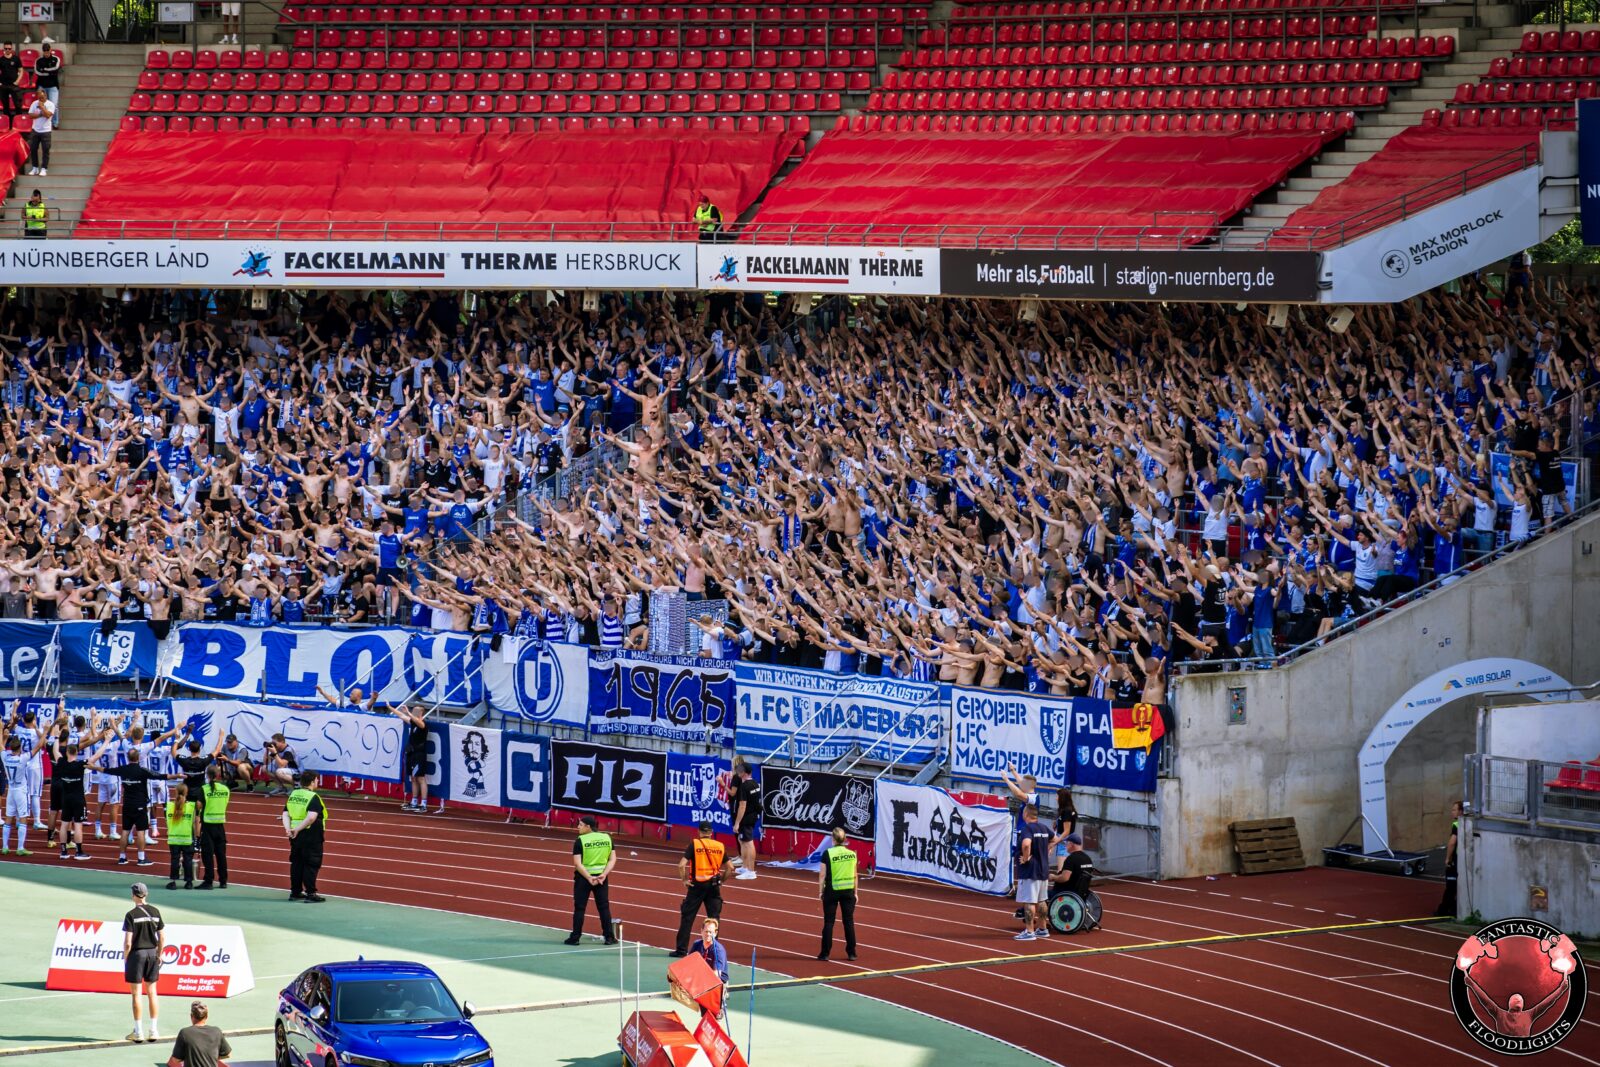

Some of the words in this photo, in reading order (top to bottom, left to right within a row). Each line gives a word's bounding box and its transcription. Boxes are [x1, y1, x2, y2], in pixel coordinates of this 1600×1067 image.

[23, 6, 51, 18] FCN
[1408, 236, 1439, 256] MAX
[1440, 209, 1504, 243] MORLOCK
[13, 248, 149, 268] NÜRNBERGER
[156, 252, 209, 268] LAND
[284, 252, 446, 270] FACKELMANN
[461, 252, 557, 271] THERME
[566, 253, 681, 271] HERSBRUCK
[1413, 236, 1469, 265] STADION
[746, 255, 850, 276] FACKELMANN
[859, 257, 923, 277] THERME
[976, 263, 1012, 283] Mehr
[1016, 264, 1036, 283] als
[1040, 264, 1095, 284] Fußball
[1116, 265, 1275, 291] stadion-nuernberg.de
[173, 627, 491, 704] BLOCK
[616, 648, 626, 658] IST
[676, 655, 697, 666] NICHT
[699, 657, 735, 669] VERLOREN
[754, 668, 773, 683] WIR
[775, 669, 818, 689] KÄMPFEN
[819, 678, 834, 691] MIT
[885, 683, 933, 701] FÄUSTEN
[1465, 674, 1485, 686] SWB
[1486, 669, 1511, 682] SOLAR
[739, 692, 790, 725] 1.FC
[956, 721, 988, 746] 1.FC
[1075, 712, 1111, 735] PLA
[956, 746, 1065, 780] MAGDEBURG
[1093, 746, 1130, 771] OST
[5, 765, 17, 780] 17
[507, 740, 543, 803] G
[763, 774, 843, 825] Sued
[691, 810, 732, 827] BLOCK
[891, 799, 998, 883] Fanatismus
